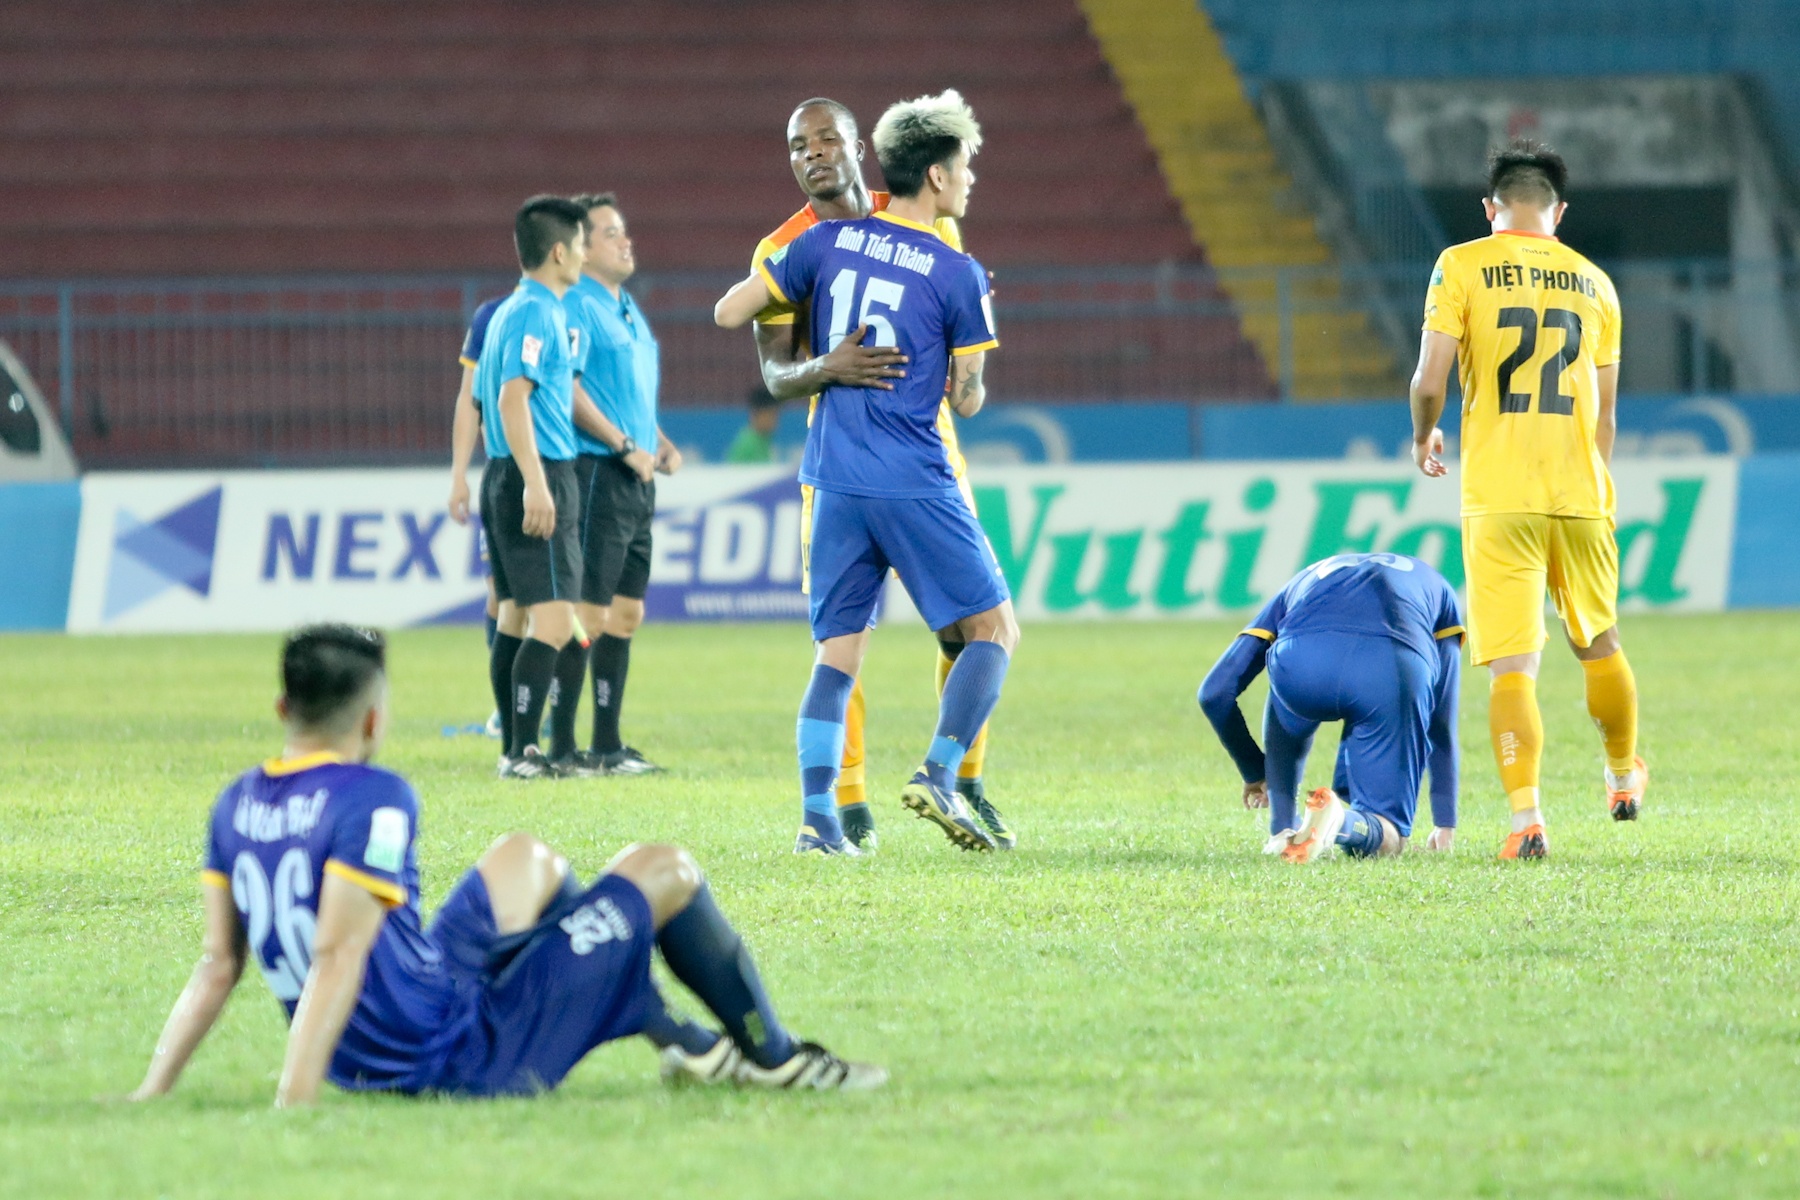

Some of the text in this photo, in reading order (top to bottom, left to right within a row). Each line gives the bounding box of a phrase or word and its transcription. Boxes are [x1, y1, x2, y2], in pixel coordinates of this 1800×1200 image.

[864, 233, 894, 263] Tiến
[893, 242, 935, 277] Thành
[1481, 261, 1597, 299] VIỆT PHONG
[829, 268, 905, 369] 15
[1496, 306, 1583, 416] 22
[1500, 731, 1520, 767] mitre
[231, 848, 318, 1000] 26
